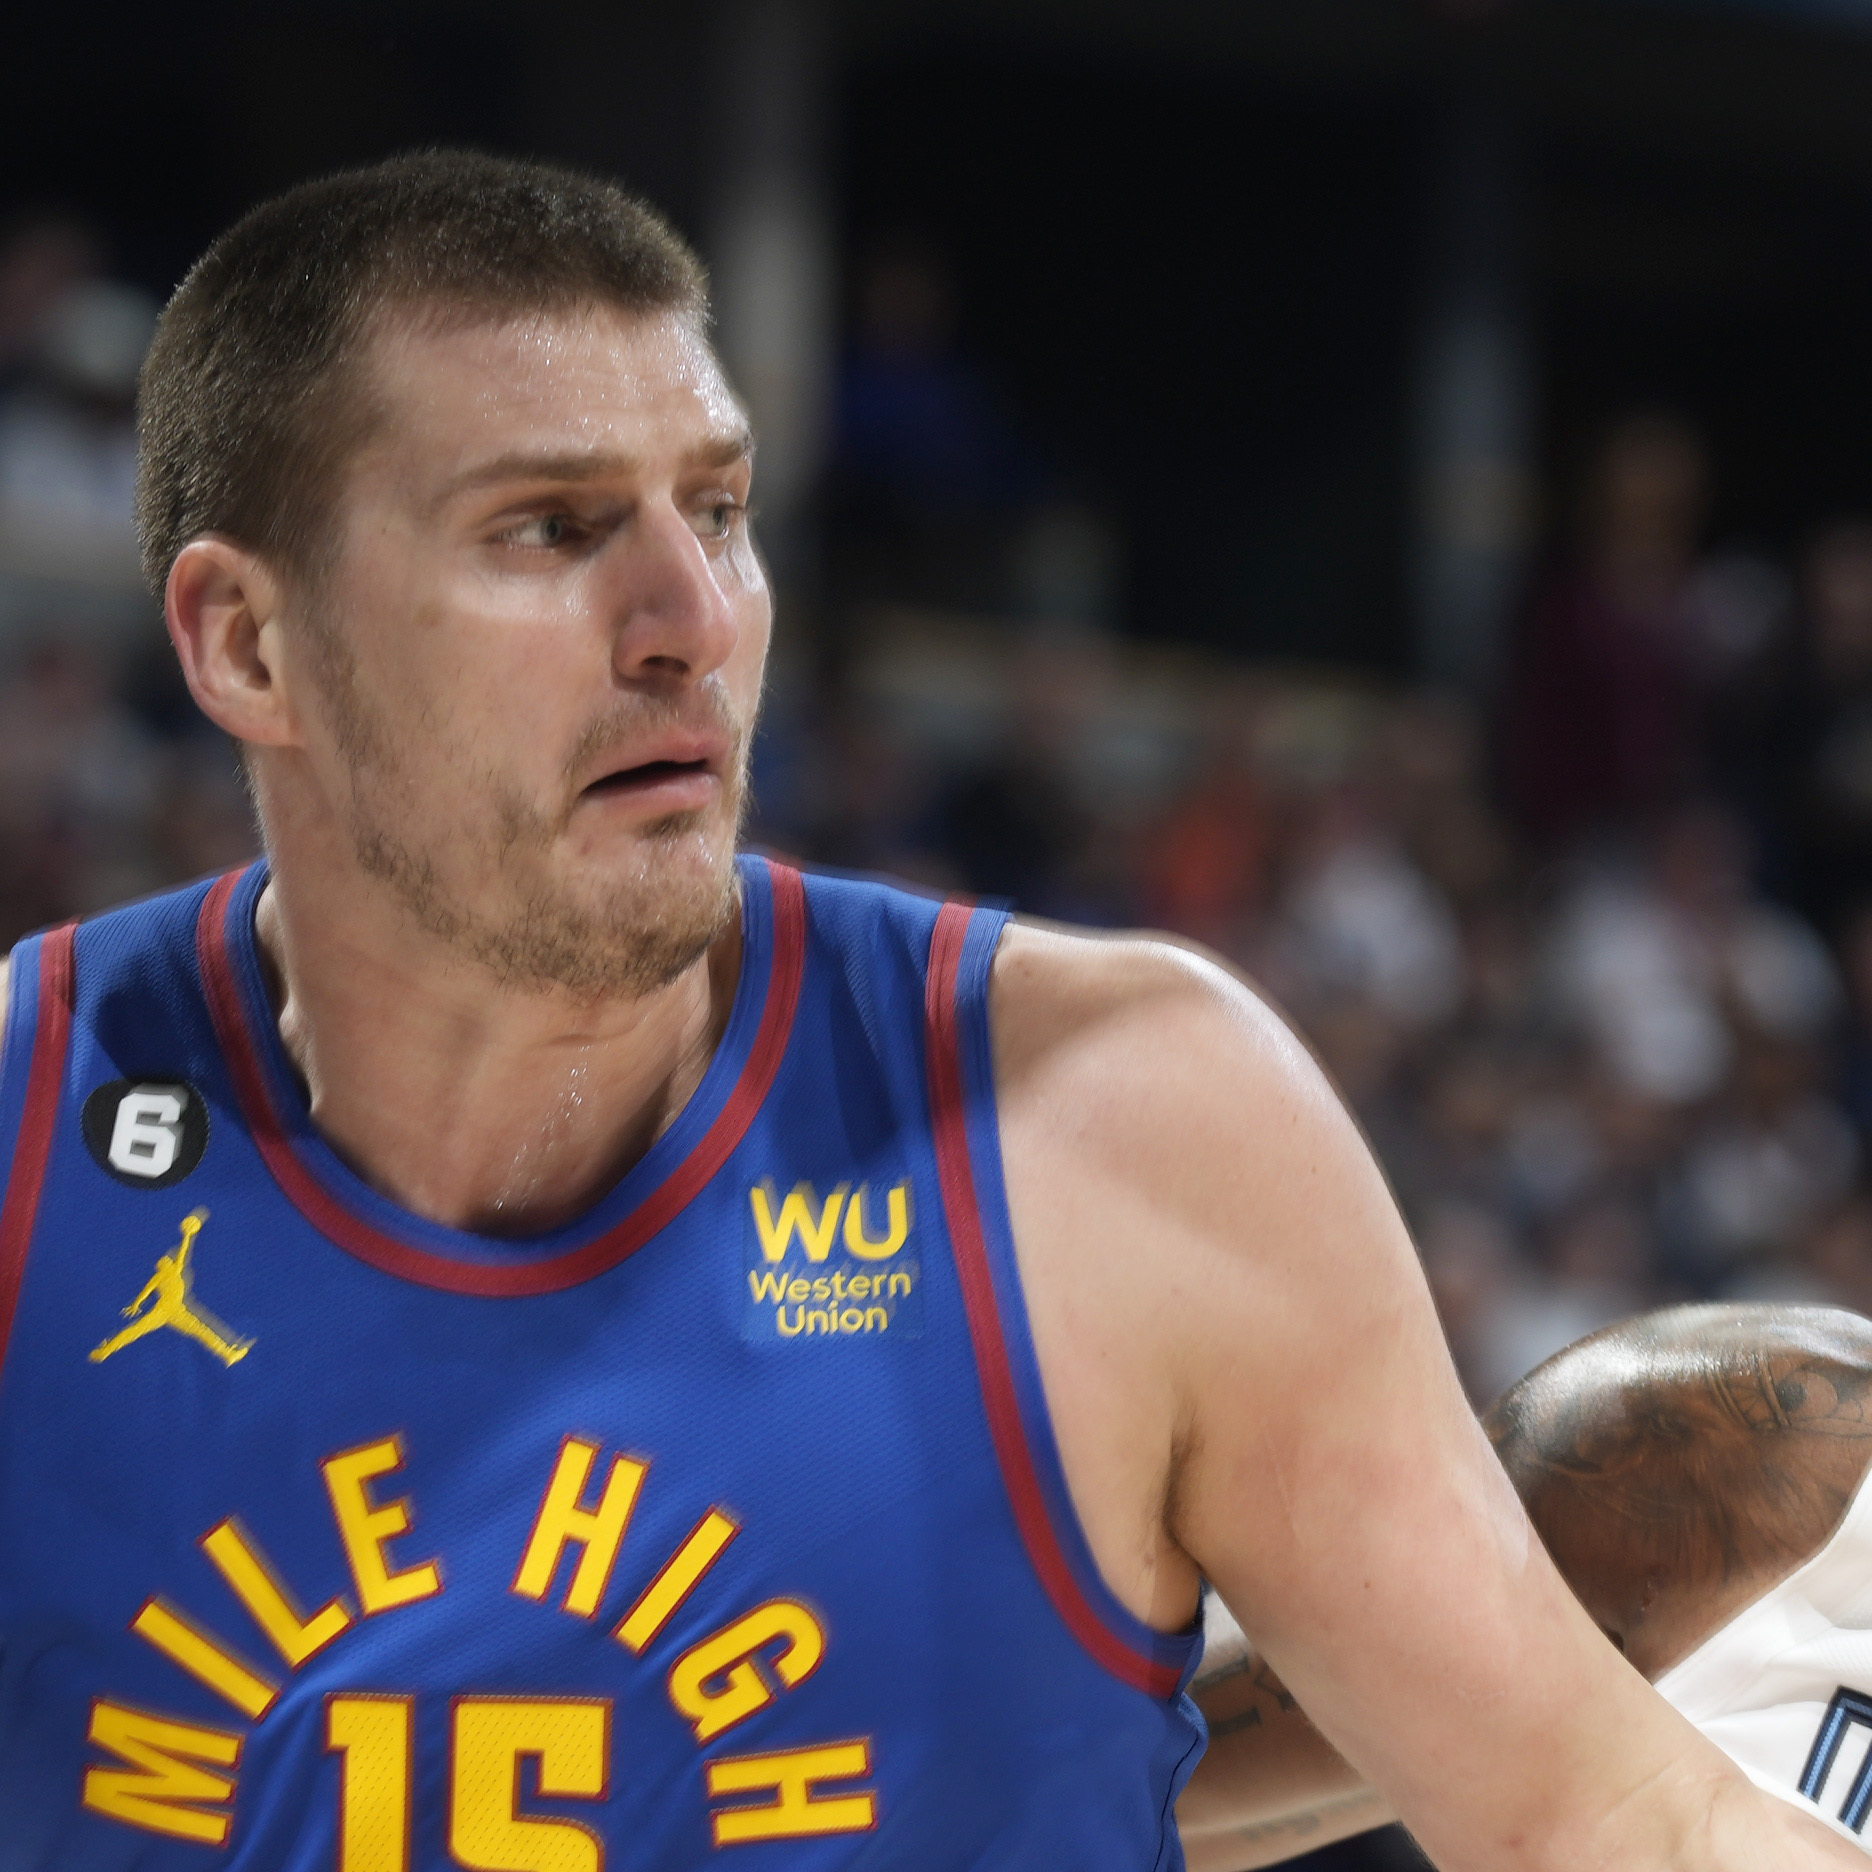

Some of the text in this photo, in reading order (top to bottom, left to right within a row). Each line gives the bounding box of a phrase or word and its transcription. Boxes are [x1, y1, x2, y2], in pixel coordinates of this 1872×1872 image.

[108, 1083, 188, 1179] 6
[749, 1180, 912, 1263] WU
[747, 1267, 915, 1304] Western
[777, 1300, 890, 1337] Union
[80, 1433, 878, 1849] MILE HIGH
